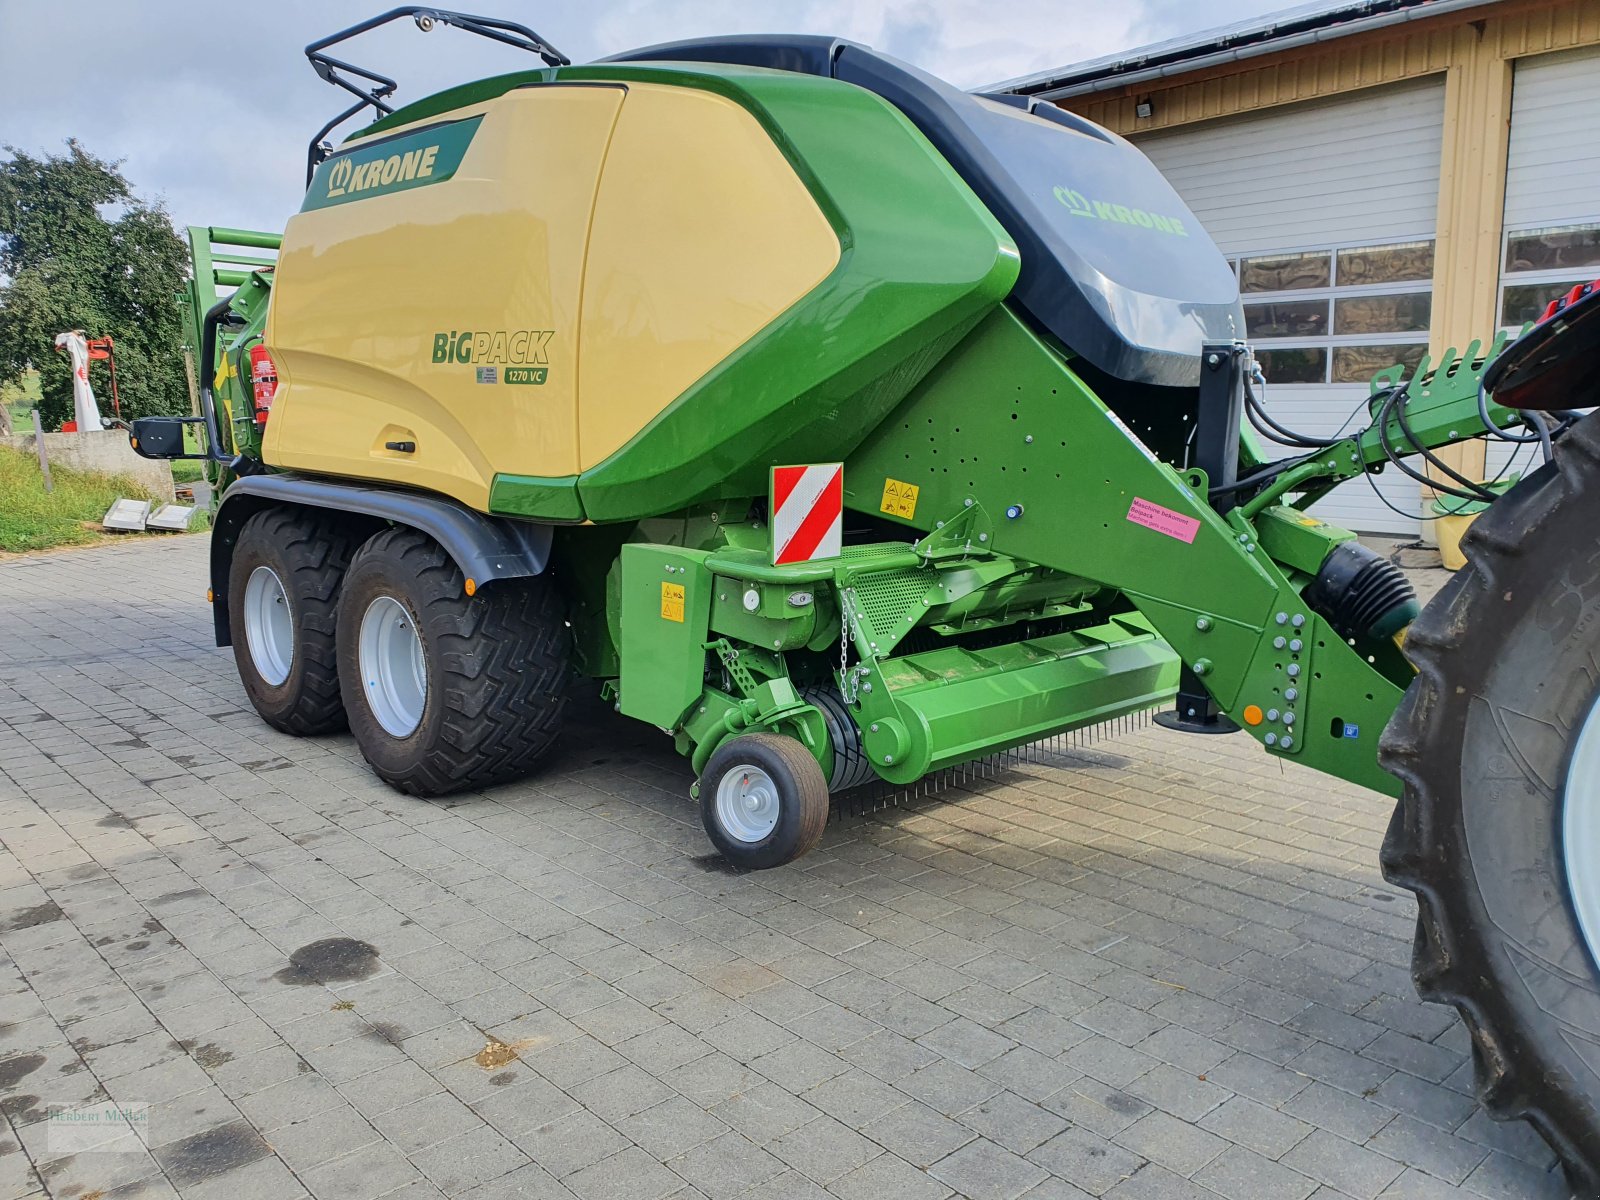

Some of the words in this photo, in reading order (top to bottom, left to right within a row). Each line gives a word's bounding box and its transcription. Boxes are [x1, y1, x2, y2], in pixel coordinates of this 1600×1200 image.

[347, 145, 440, 193] KRONE
[1092, 200, 1189, 237] KRONE
[508, 371, 528, 382] 1270
[530, 371, 543, 382] VC
[1133, 500, 1160, 514] Maschine
[1161, 511, 1189, 525] bekommt
